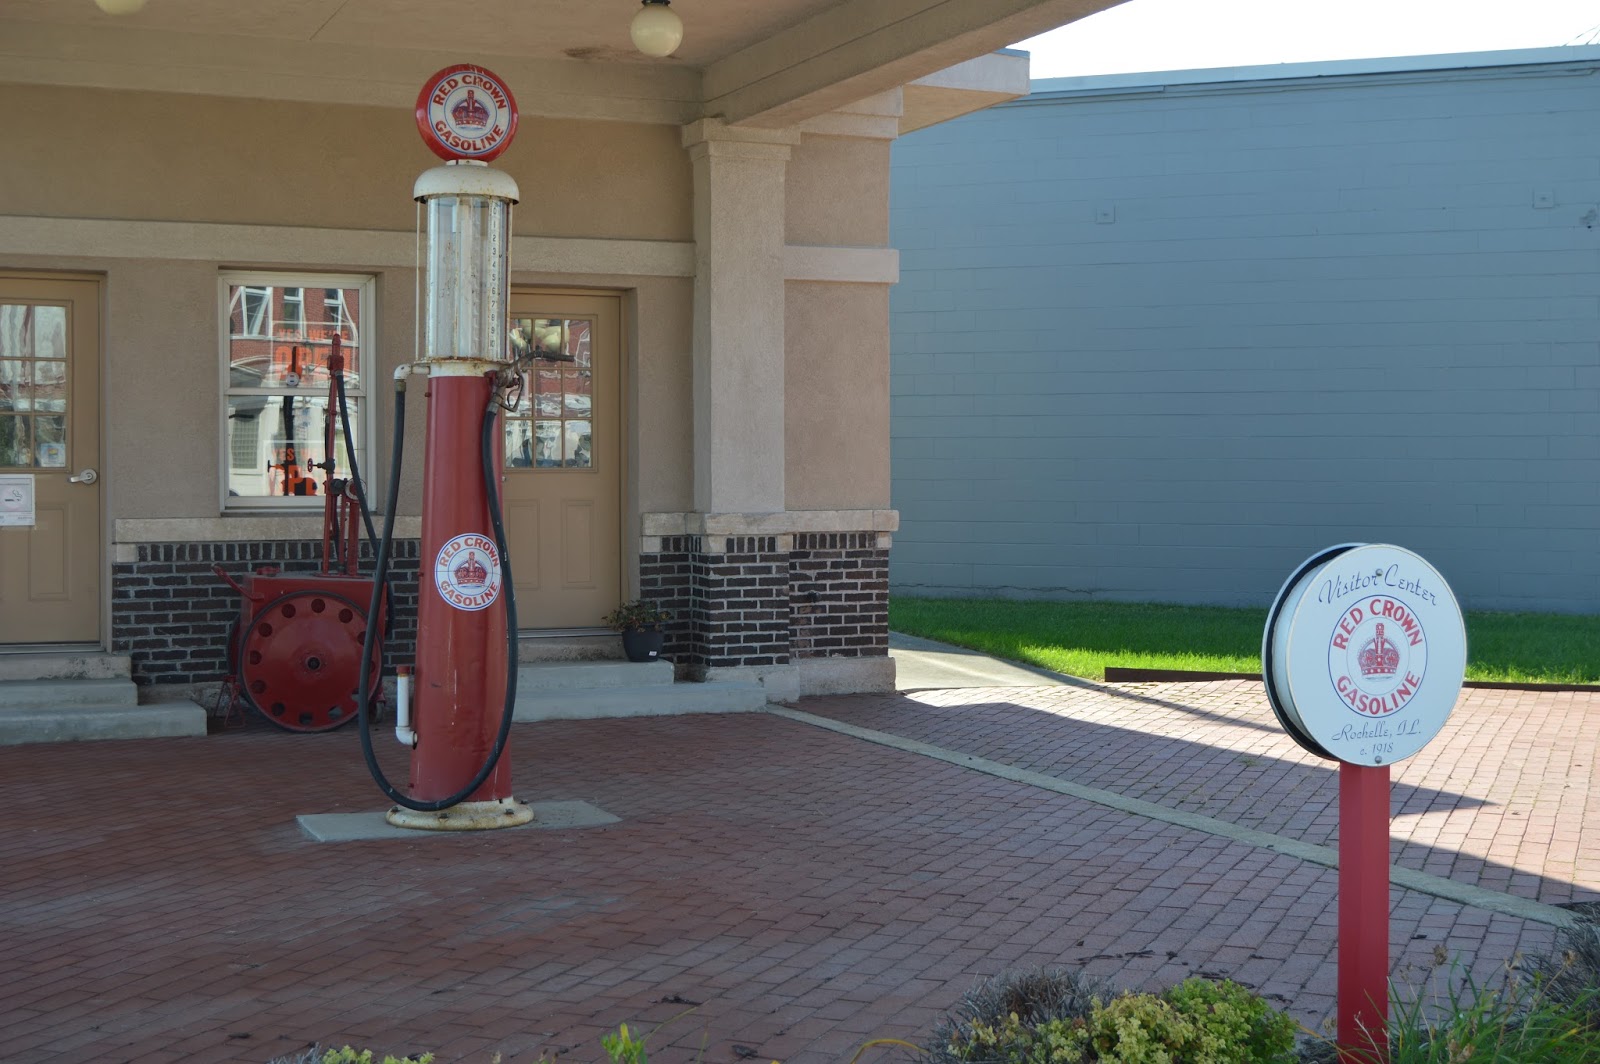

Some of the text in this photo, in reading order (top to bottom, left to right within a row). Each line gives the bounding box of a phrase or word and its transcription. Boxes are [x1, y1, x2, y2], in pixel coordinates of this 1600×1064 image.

[433, 74, 507, 109] RED CROWN
[435, 120, 504, 151] GASOLINE
[492, 234, 497, 242] 2
[492, 247, 497, 255] 3
[492, 273, 496, 281] 5
[491, 287, 496, 295] 6
[491, 300, 496, 308] 7
[278, 328, 303, 342] YES
[272, 448, 294, 461] YES
[439, 537, 499, 568] RED CROWN
[441, 580, 498, 606] GASOLINE
[1318, 563, 1437, 606] Visitor Center
[1333, 598, 1423, 650] RED CROWN
[1337, 670, 1421, 715] GASOLINE
[1331, 721, 1392, 742] Rochelle,
[1372, 742, 1394, 754] 1918
